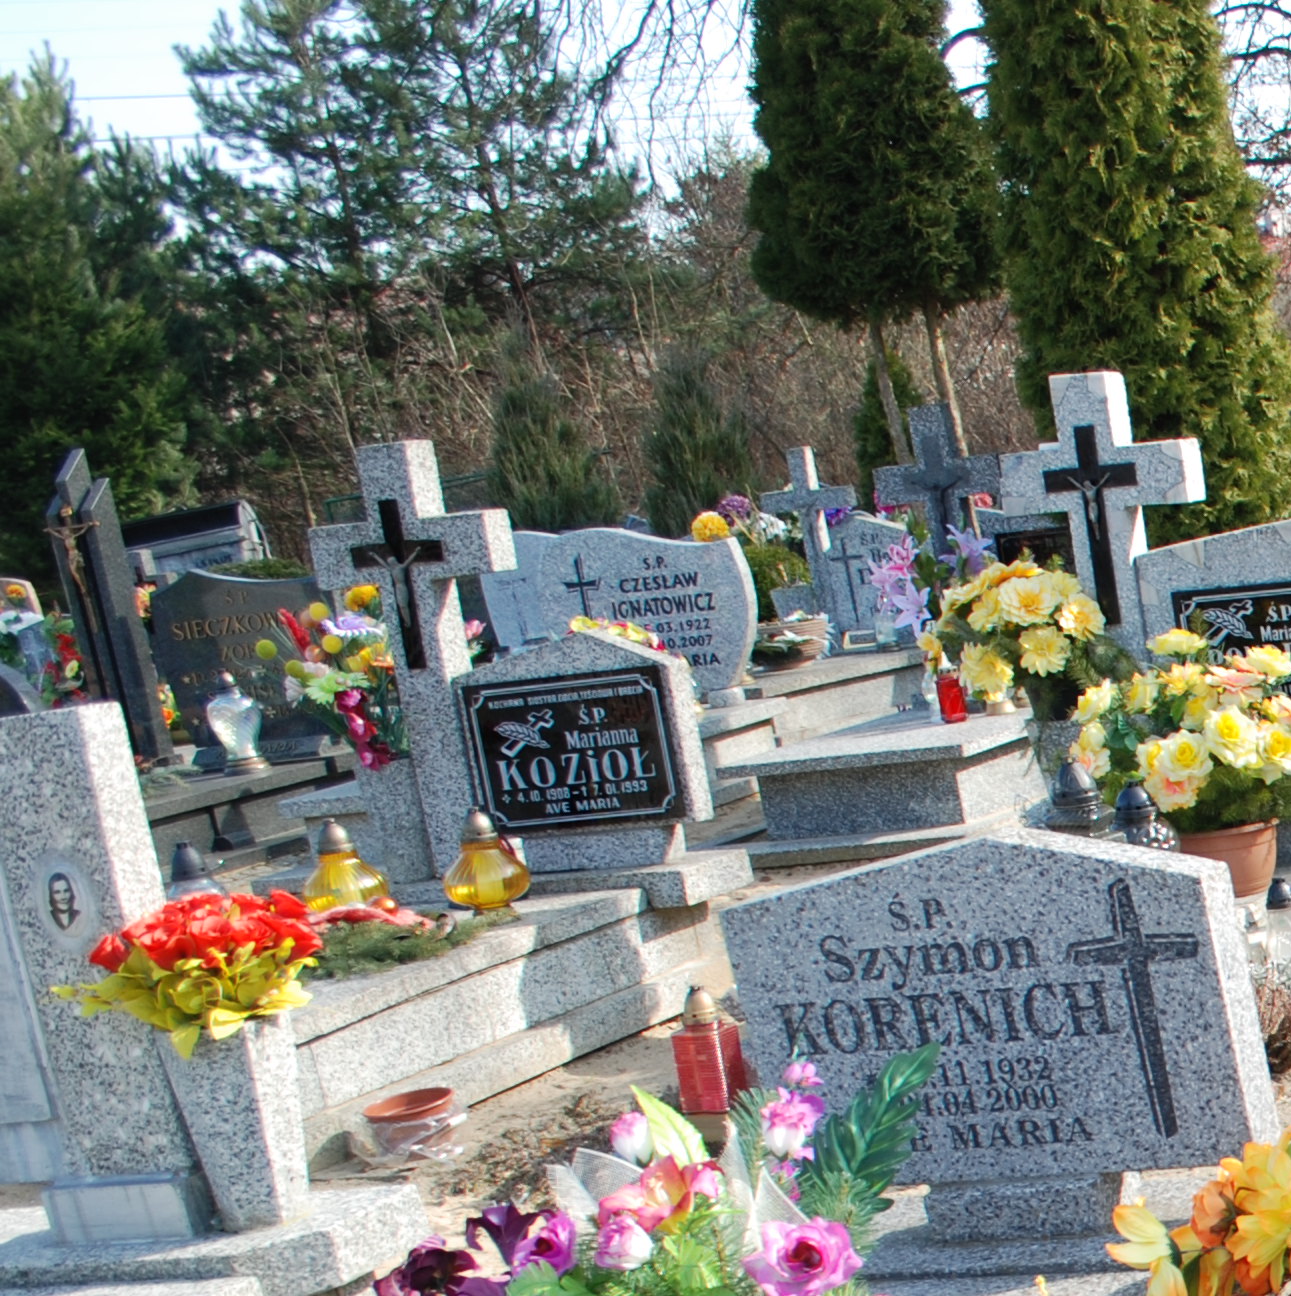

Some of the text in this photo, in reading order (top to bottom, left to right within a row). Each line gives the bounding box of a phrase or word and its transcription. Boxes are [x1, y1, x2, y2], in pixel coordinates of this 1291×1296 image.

[618, 571, 700, 594] CZESŁAW
[611, 592, 716, 621] IGNATOWICZ
[172, 610, 300, 642] SIECZKOW
[577, 703, 609, 726] Ś.P.
[564, 726, 640, 750] Marianna
[545, 797, 621, 815] AVE MARIA
[887, 892, 954, 932] Ś.P.
[819, 934, 1041, 991] Szymon
[775, 980, 1125, 1059] KORENICH
[950, 1117, 1095, 1151] MARIA
